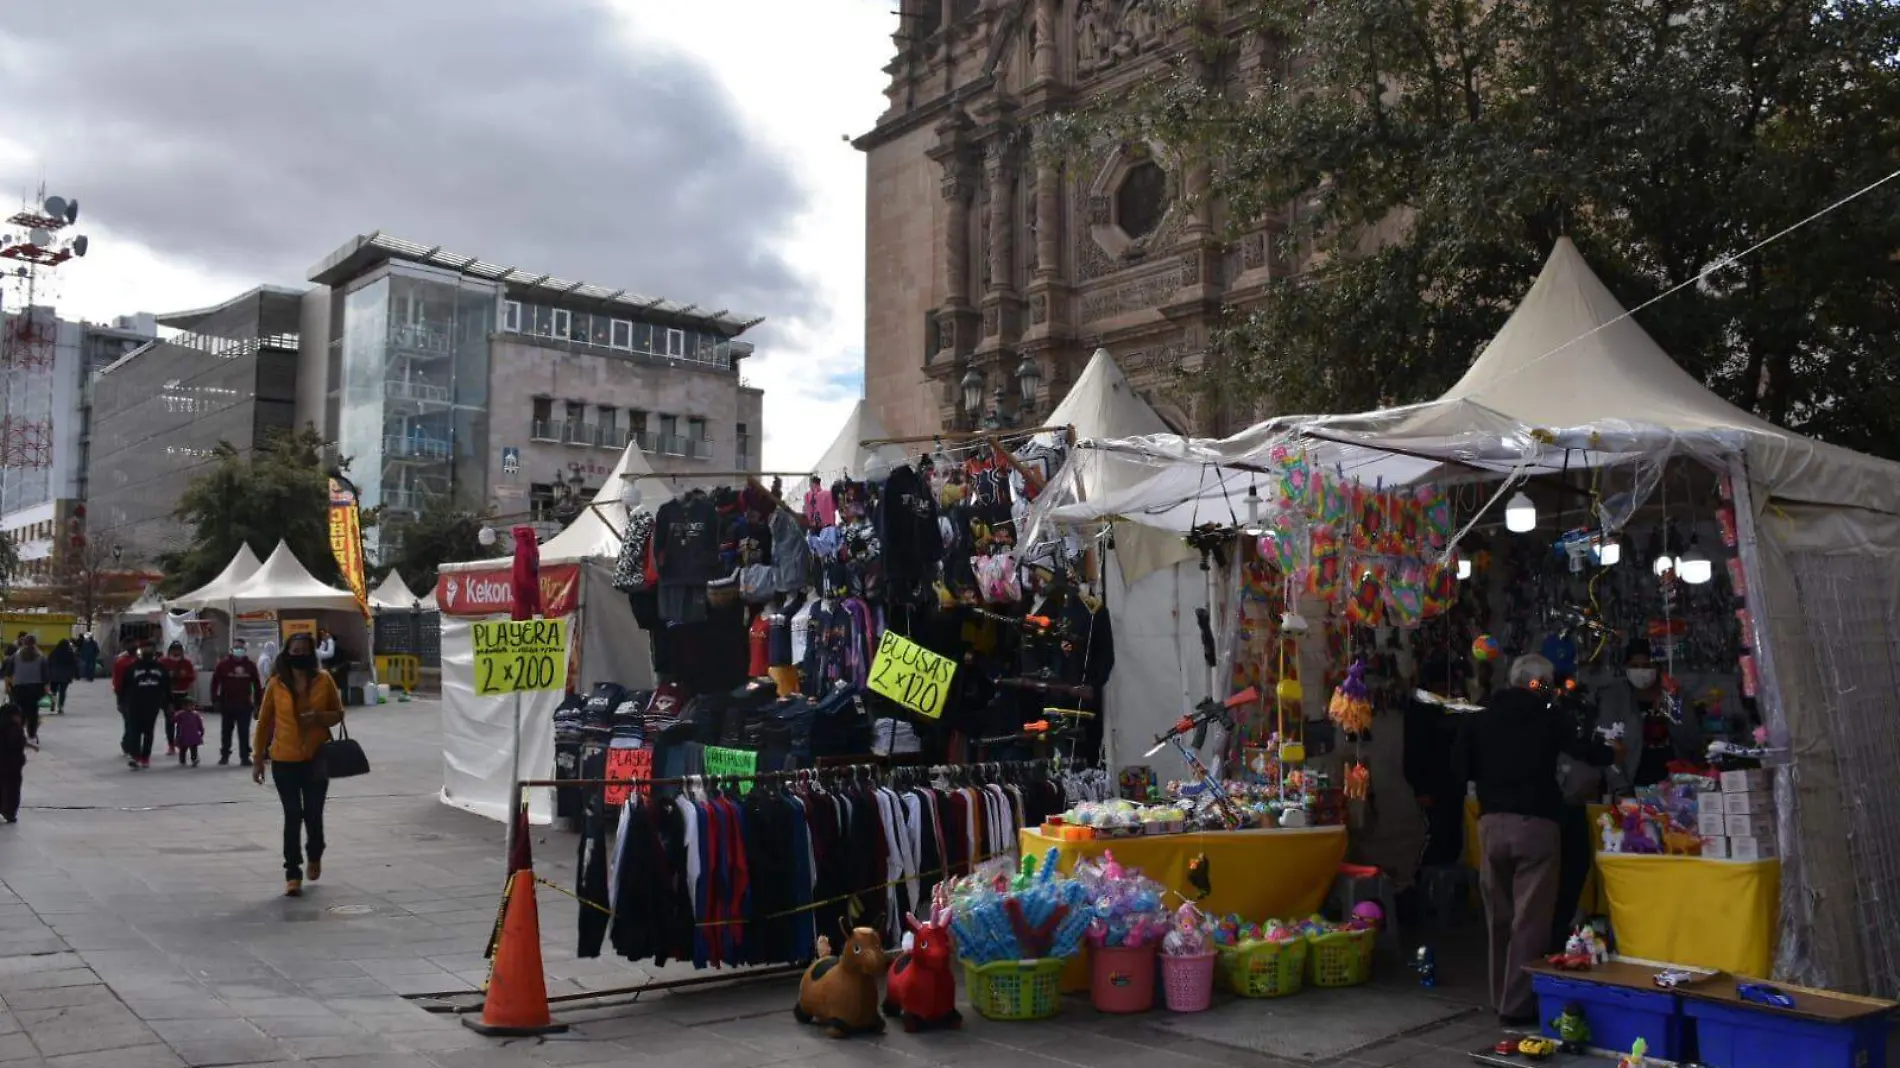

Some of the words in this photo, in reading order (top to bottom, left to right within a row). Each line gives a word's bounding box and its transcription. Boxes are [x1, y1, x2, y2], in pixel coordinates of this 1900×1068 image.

[466, 575, 514, 604] Kekon
[473, 620, 560, 648] PLAYERA
[482, 656, 500, 693] 2
[512, 655, 555, 692] 200
[880, 631, 953, 683] BLUSAS
[872, 657, 892, 690] 2
[903, 671, 939, 713] 120
